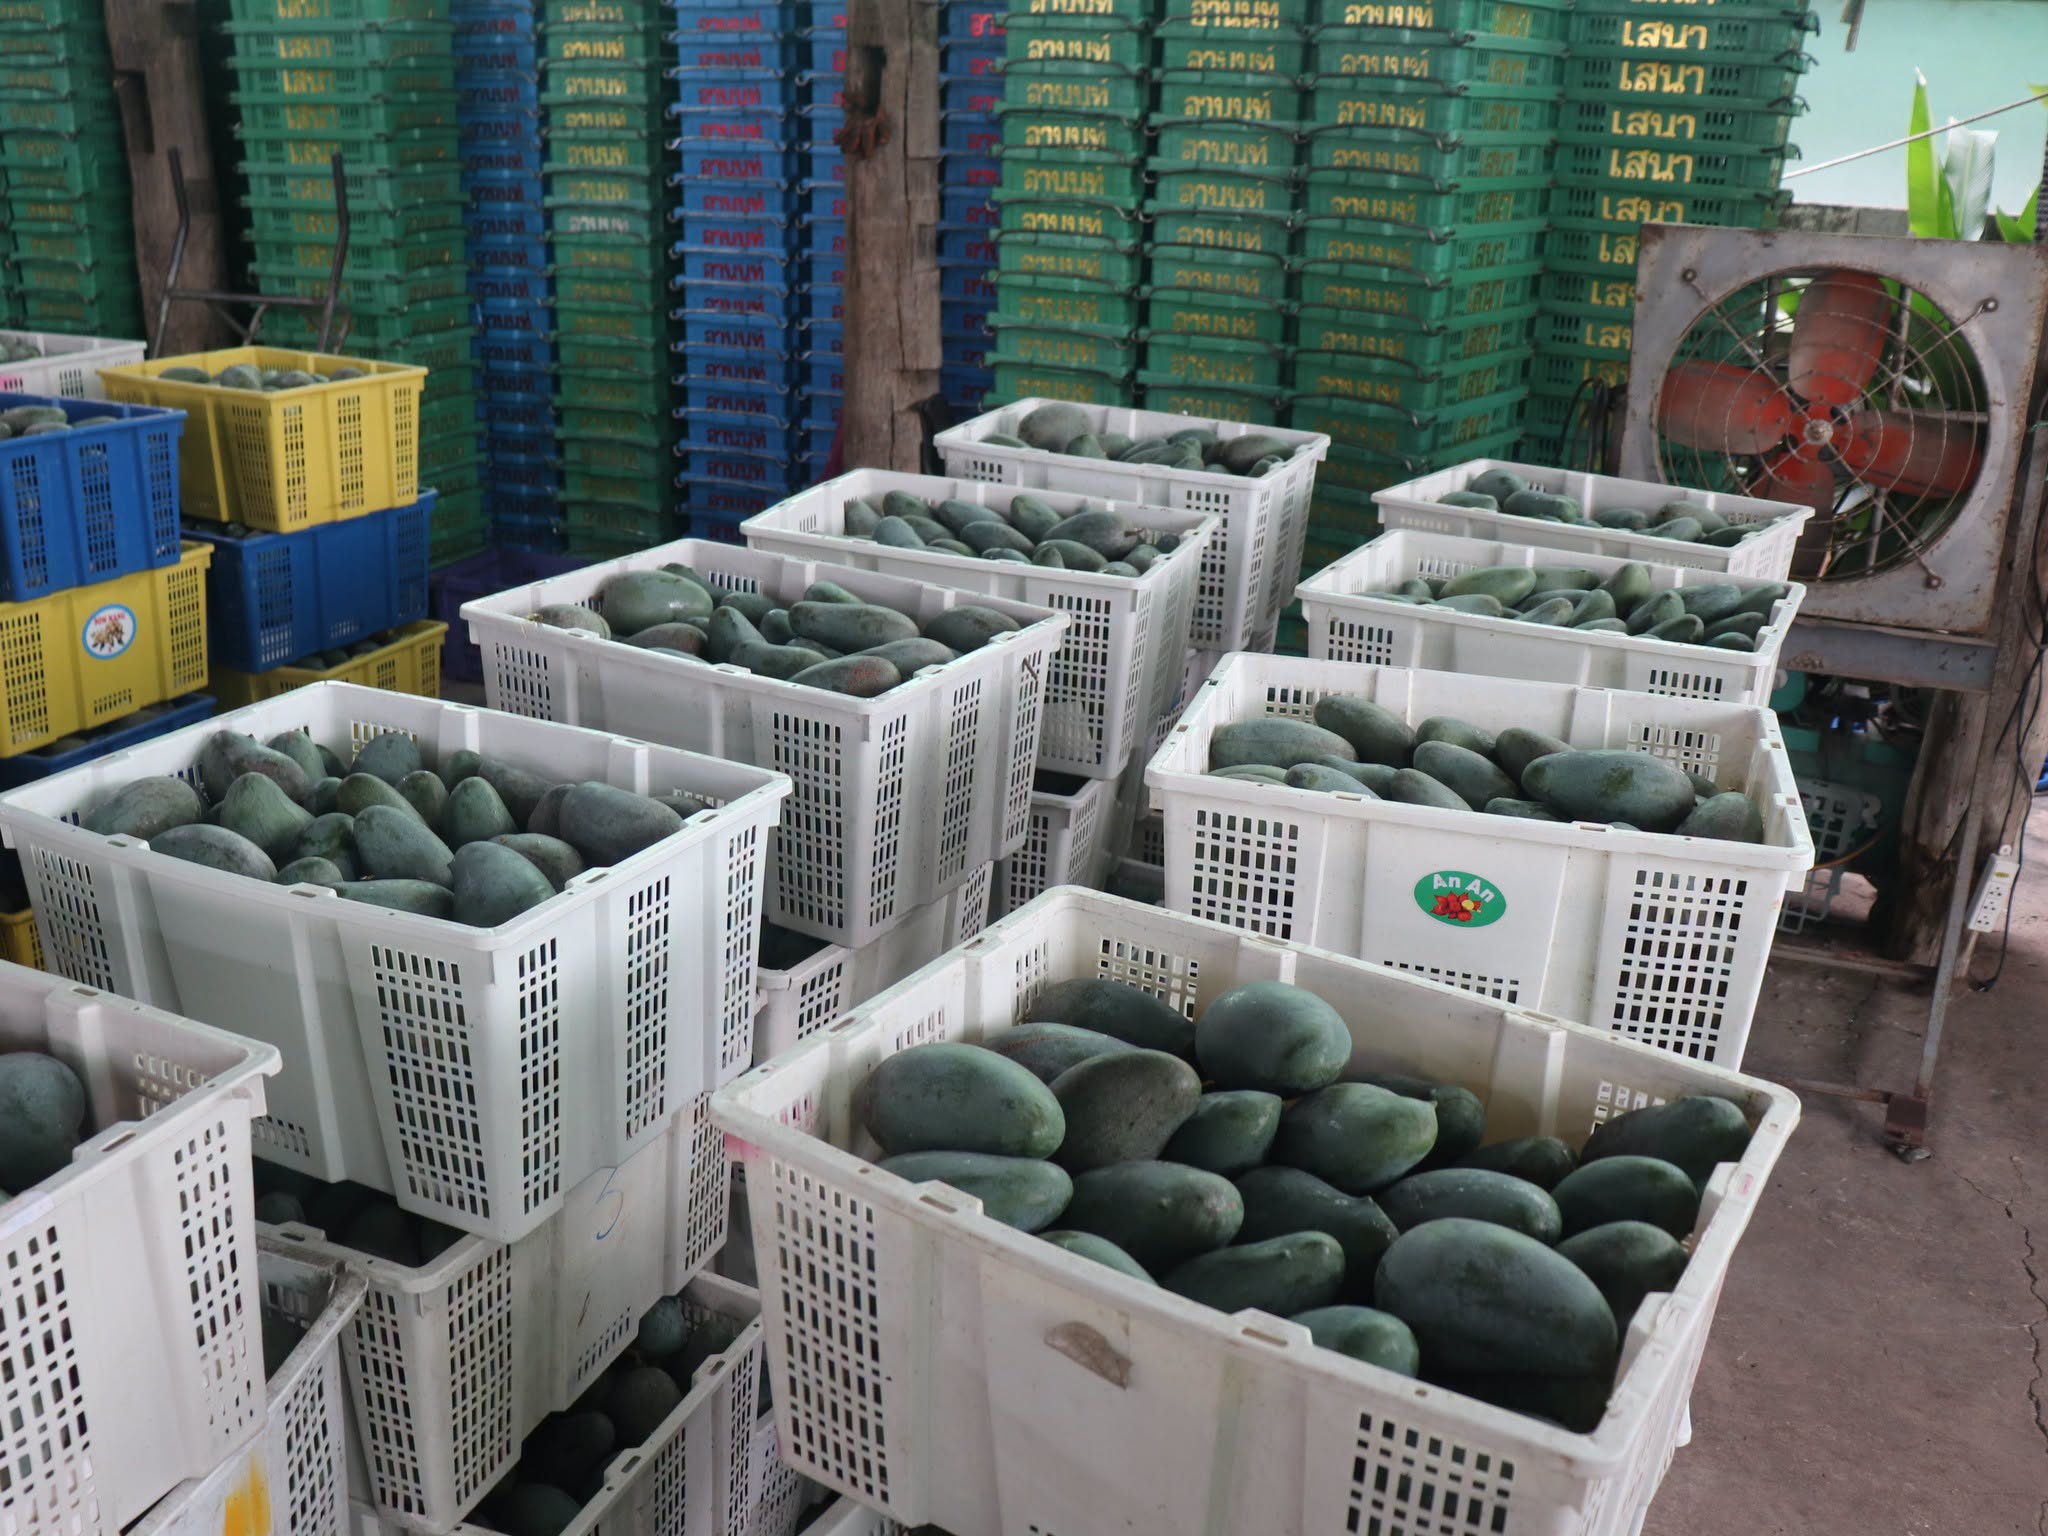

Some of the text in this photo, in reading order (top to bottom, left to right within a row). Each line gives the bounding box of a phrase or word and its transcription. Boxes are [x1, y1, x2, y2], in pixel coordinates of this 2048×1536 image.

[1622, 20, 1708, 50] เสนา
[1619, 60, 1705, 95] เสนา
[1612, 110, 1696, 140] เสนา
[1609, 149, 1693, 183] เสนา
[1602, 195, 1685, 224] เสนา
[1599, 233, 1638, 265] เส
[1591, 280, 1634, 307] เส
[1433, 873, 1495, 903] An An
